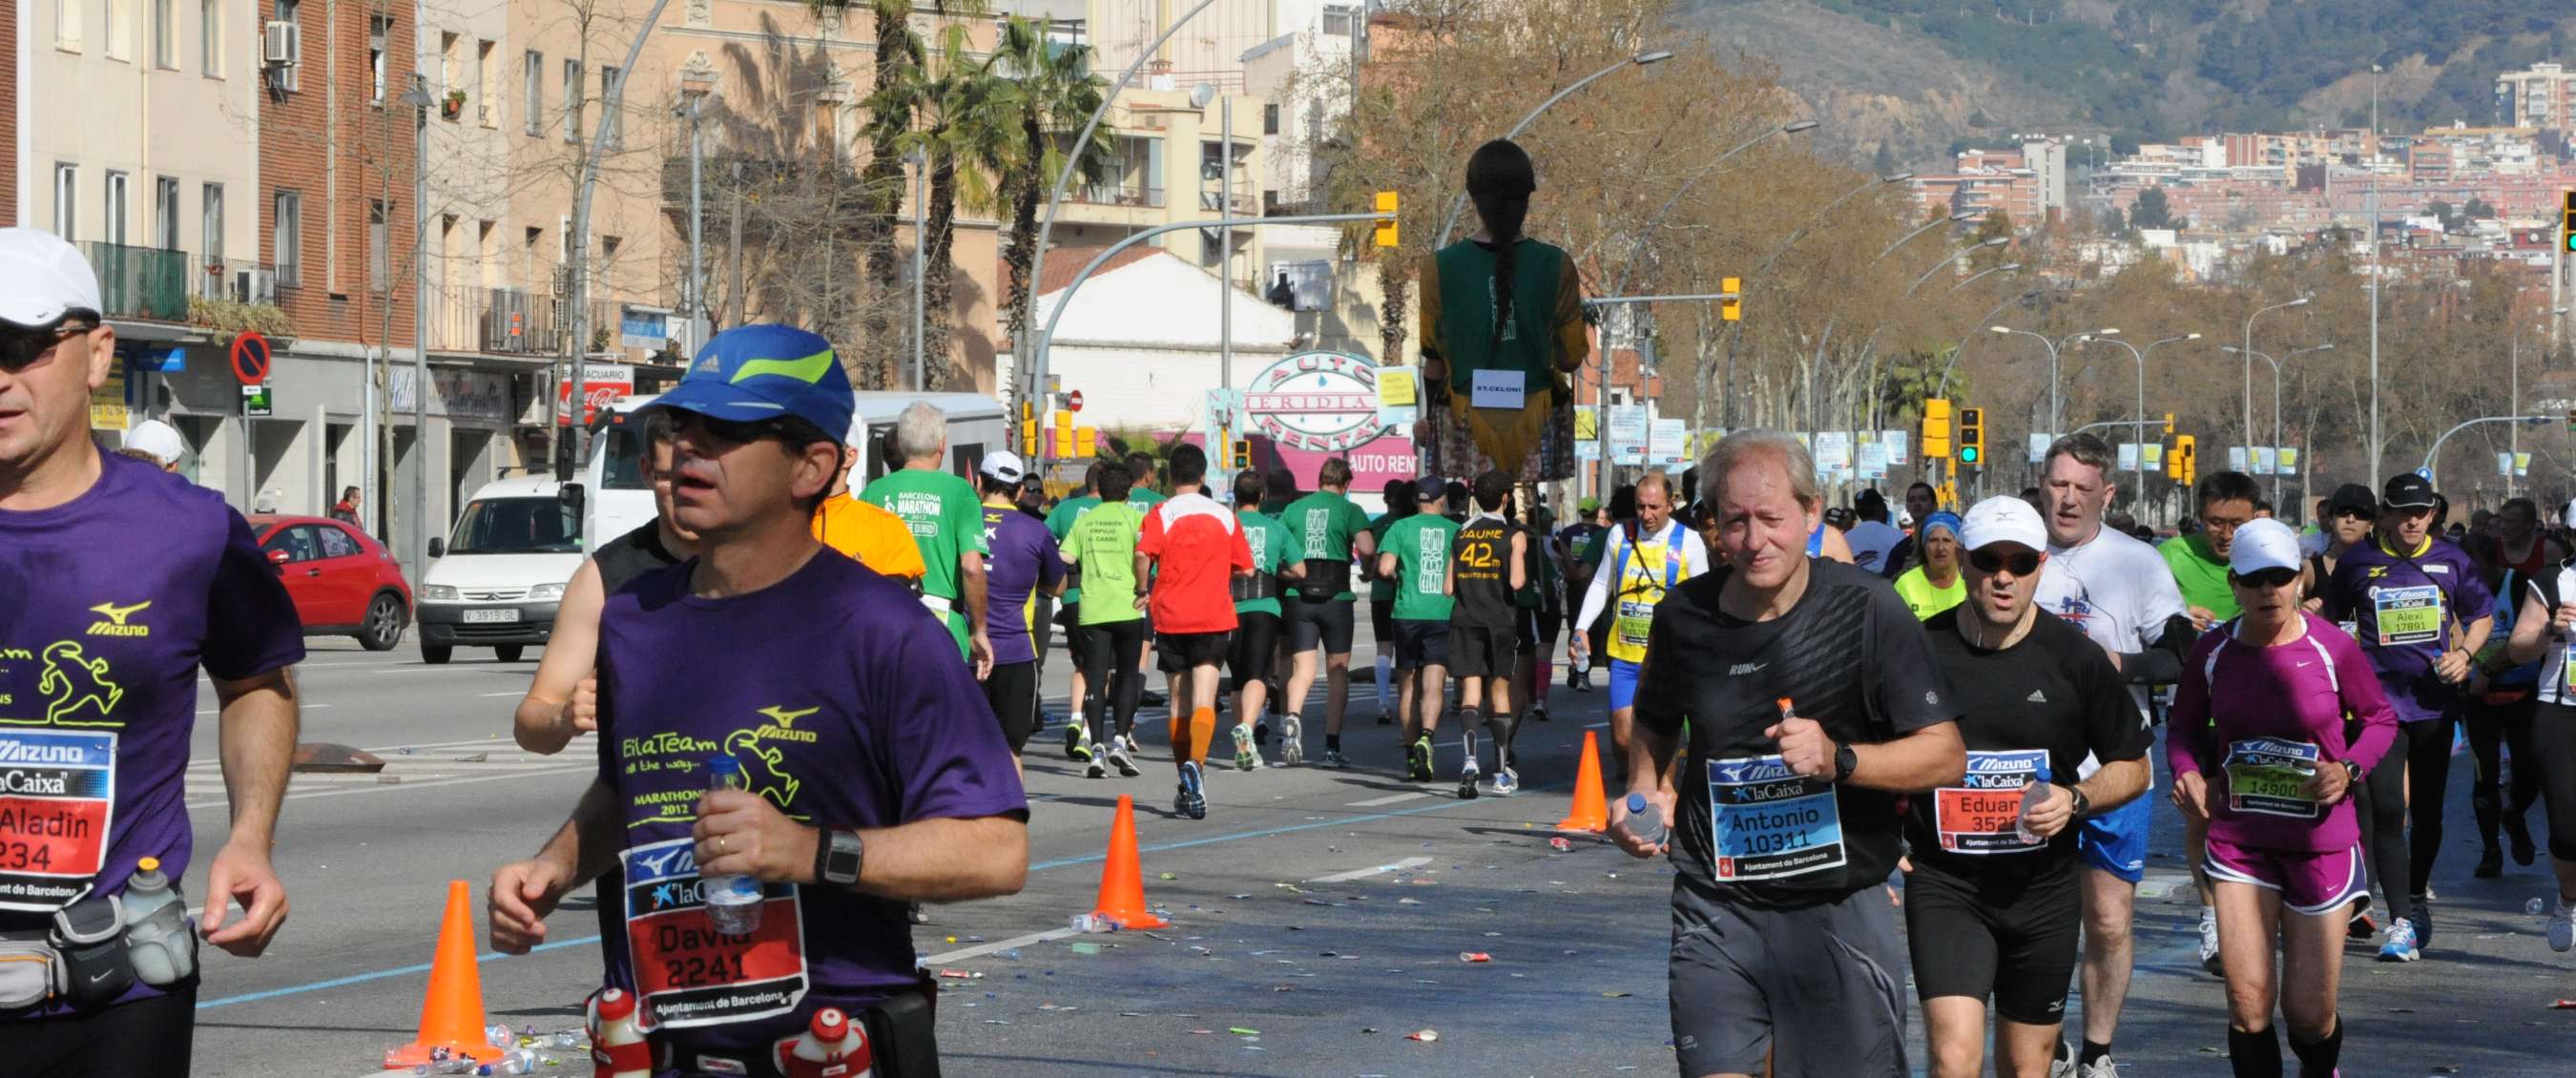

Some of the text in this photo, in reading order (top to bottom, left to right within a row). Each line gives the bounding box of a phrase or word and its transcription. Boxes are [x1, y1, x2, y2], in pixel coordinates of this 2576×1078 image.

[585, 370, 625, 380] ACUARIO
[1270, 355, 1376, 386] AUTO
[1349, 455, 1384, 473] AUTO
[897, 499, 941, 516] MARATHON
[1460, 529, 1503, 539] JAUME
[2398, 612, 2423, 622] Alexi
[2396, 622, 2426, 632] 17891
[1729, 663, 1755, 676] RUN
[640, 760, 660, 772] the
[634, 789, 707, 806] MARATHON
[2250, 780, 2298, 798] 14900
[660, 804, 689, 816] 2012
[1732, 807, 1819, 833] Antonio
[1744, 829, 1812, 855] 10311
[1744, 860, 1783, 872] Ajuntament
[1794, 852, 1828, 866] Barcelona
[27, 885, 76, 897] Barcelona
[666, 954, 750, 987] 2241
[656, 990, 784, 1015] Ajuntament de Barcelona
